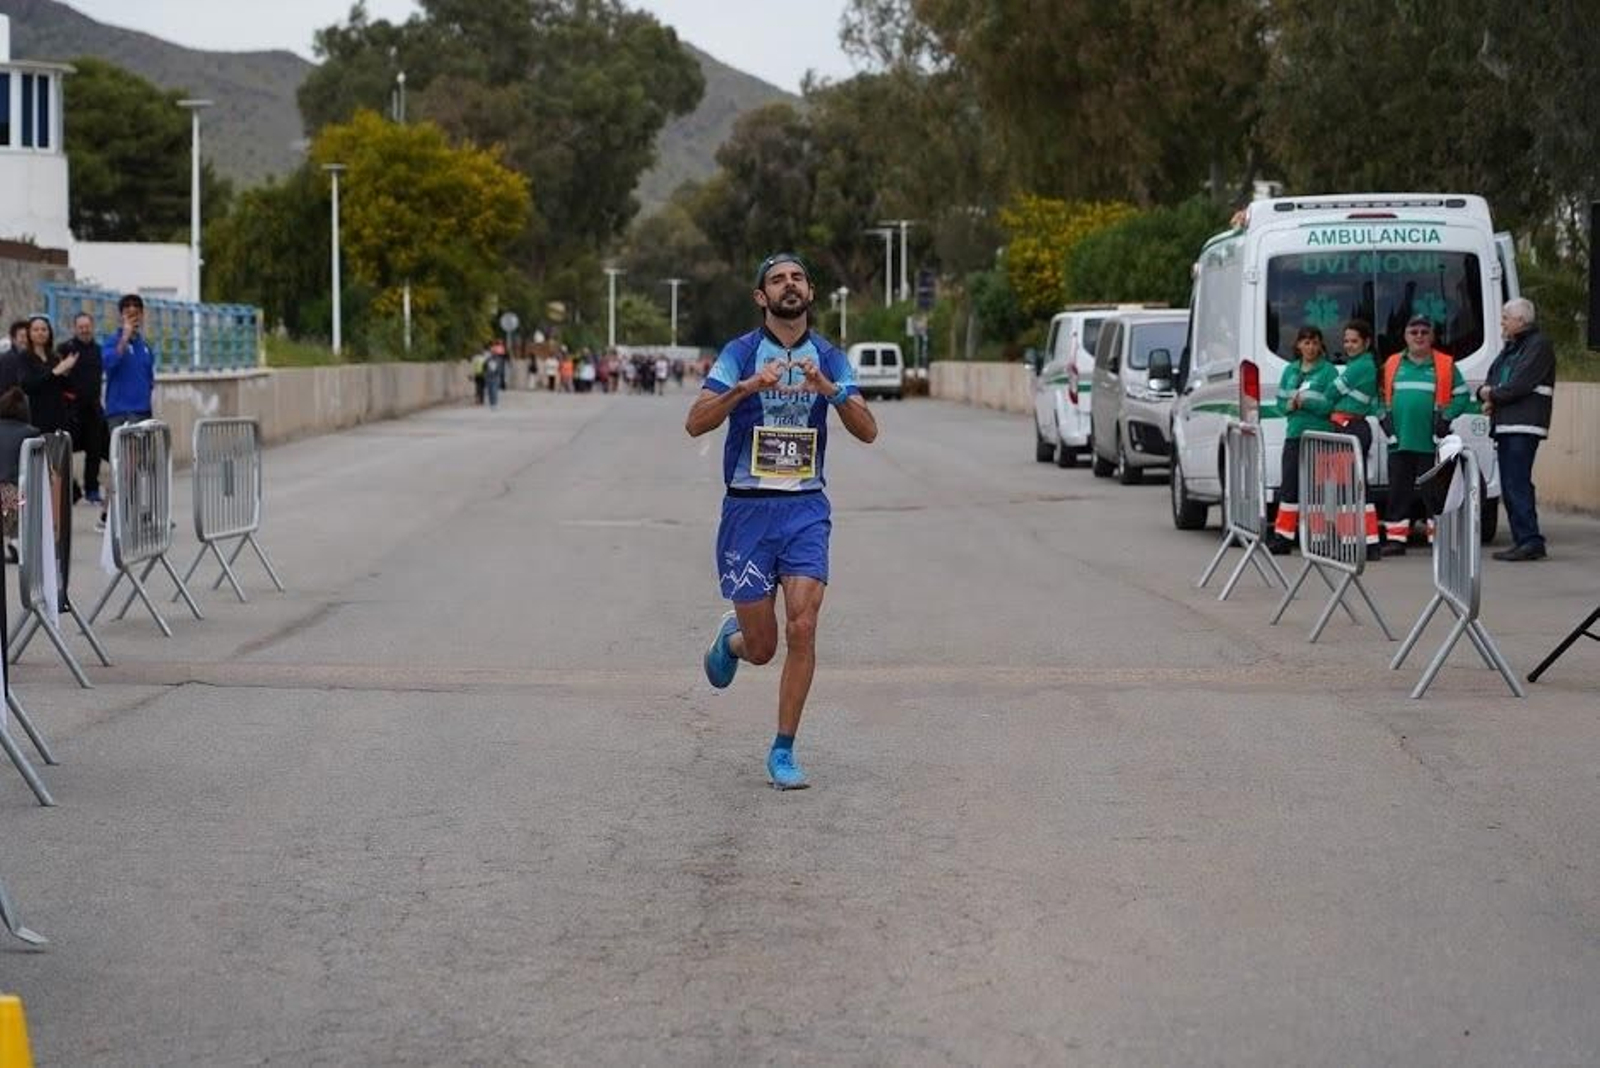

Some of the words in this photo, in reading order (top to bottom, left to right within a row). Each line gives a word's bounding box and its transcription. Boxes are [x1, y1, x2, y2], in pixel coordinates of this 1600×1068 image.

[1307, 228, 1441, 246] AMBULANCIA
[1303, 252, 1349, 275] UVI
[777, 442, 797, 456] 18
